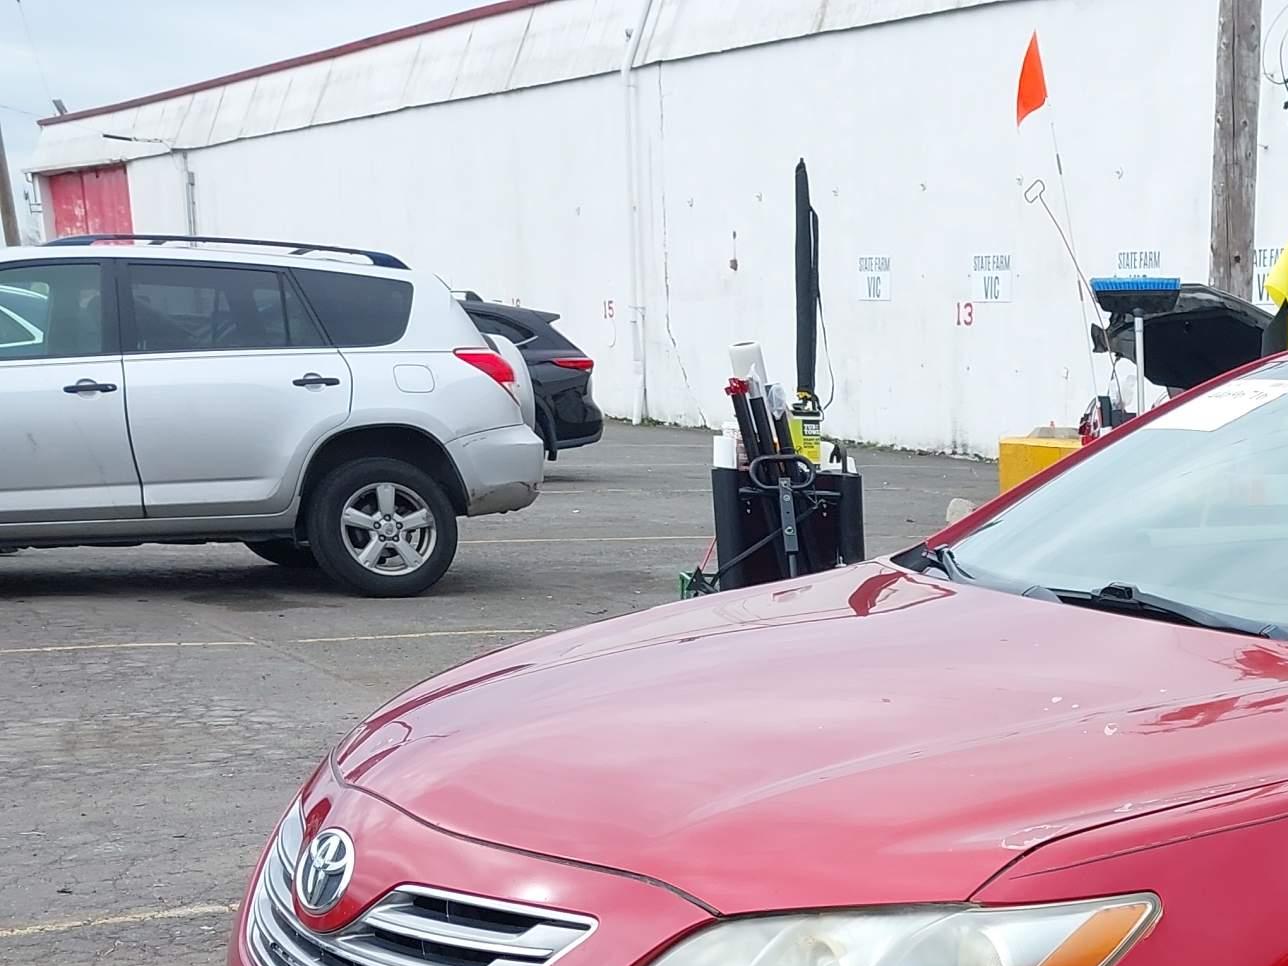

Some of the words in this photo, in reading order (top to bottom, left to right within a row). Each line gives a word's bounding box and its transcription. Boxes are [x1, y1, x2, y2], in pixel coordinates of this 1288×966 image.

[858, 257, 874, 272] STATE
[874, 256, 891, 271] FARM
[973, 255, 992, 272] STATE
[992, 254, 1011, 271] FARM
[1118, 252, 1138, 270] STATE
[1139, 250, 1161, 269] FARM
[867, 275, 882, 299] VIC
[983, 275, 1000, 300] VIC
[603, 299, 615, 319] 15
[956, 302, 974, 326] 13
